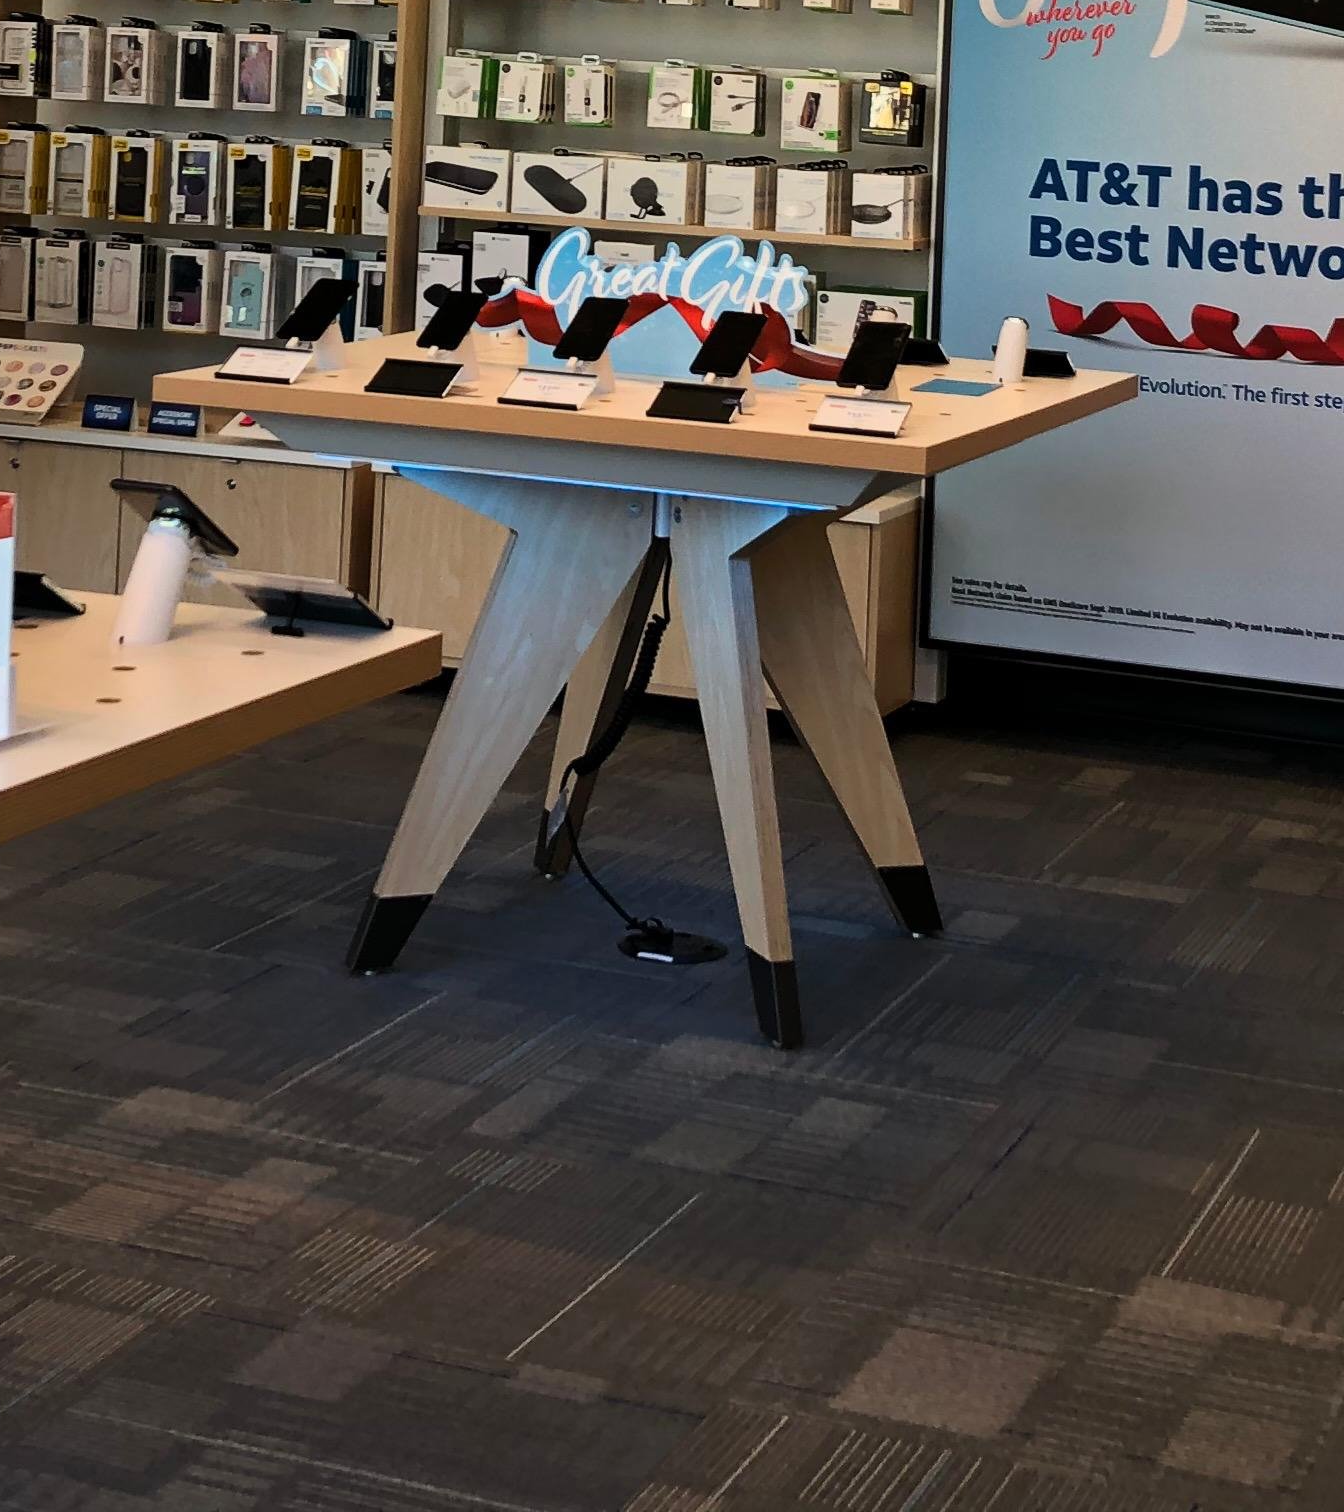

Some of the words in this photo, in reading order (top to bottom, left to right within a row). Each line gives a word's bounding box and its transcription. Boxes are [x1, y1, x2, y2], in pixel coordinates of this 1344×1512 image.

[1039, 26, 1087, 61] you
[1091, 23, 1116, 58] go
[1028, 157, 1172, 208] AT&T
[1187, 164, 1283, 217] has
[1028, 214, 1150, 266] Best
[539, 229, 684, 326] Great
[680, 237, 805, 332] Gifts
[1232, 384, 1266, 403] The
[1270, 386, 1310, 407] first
